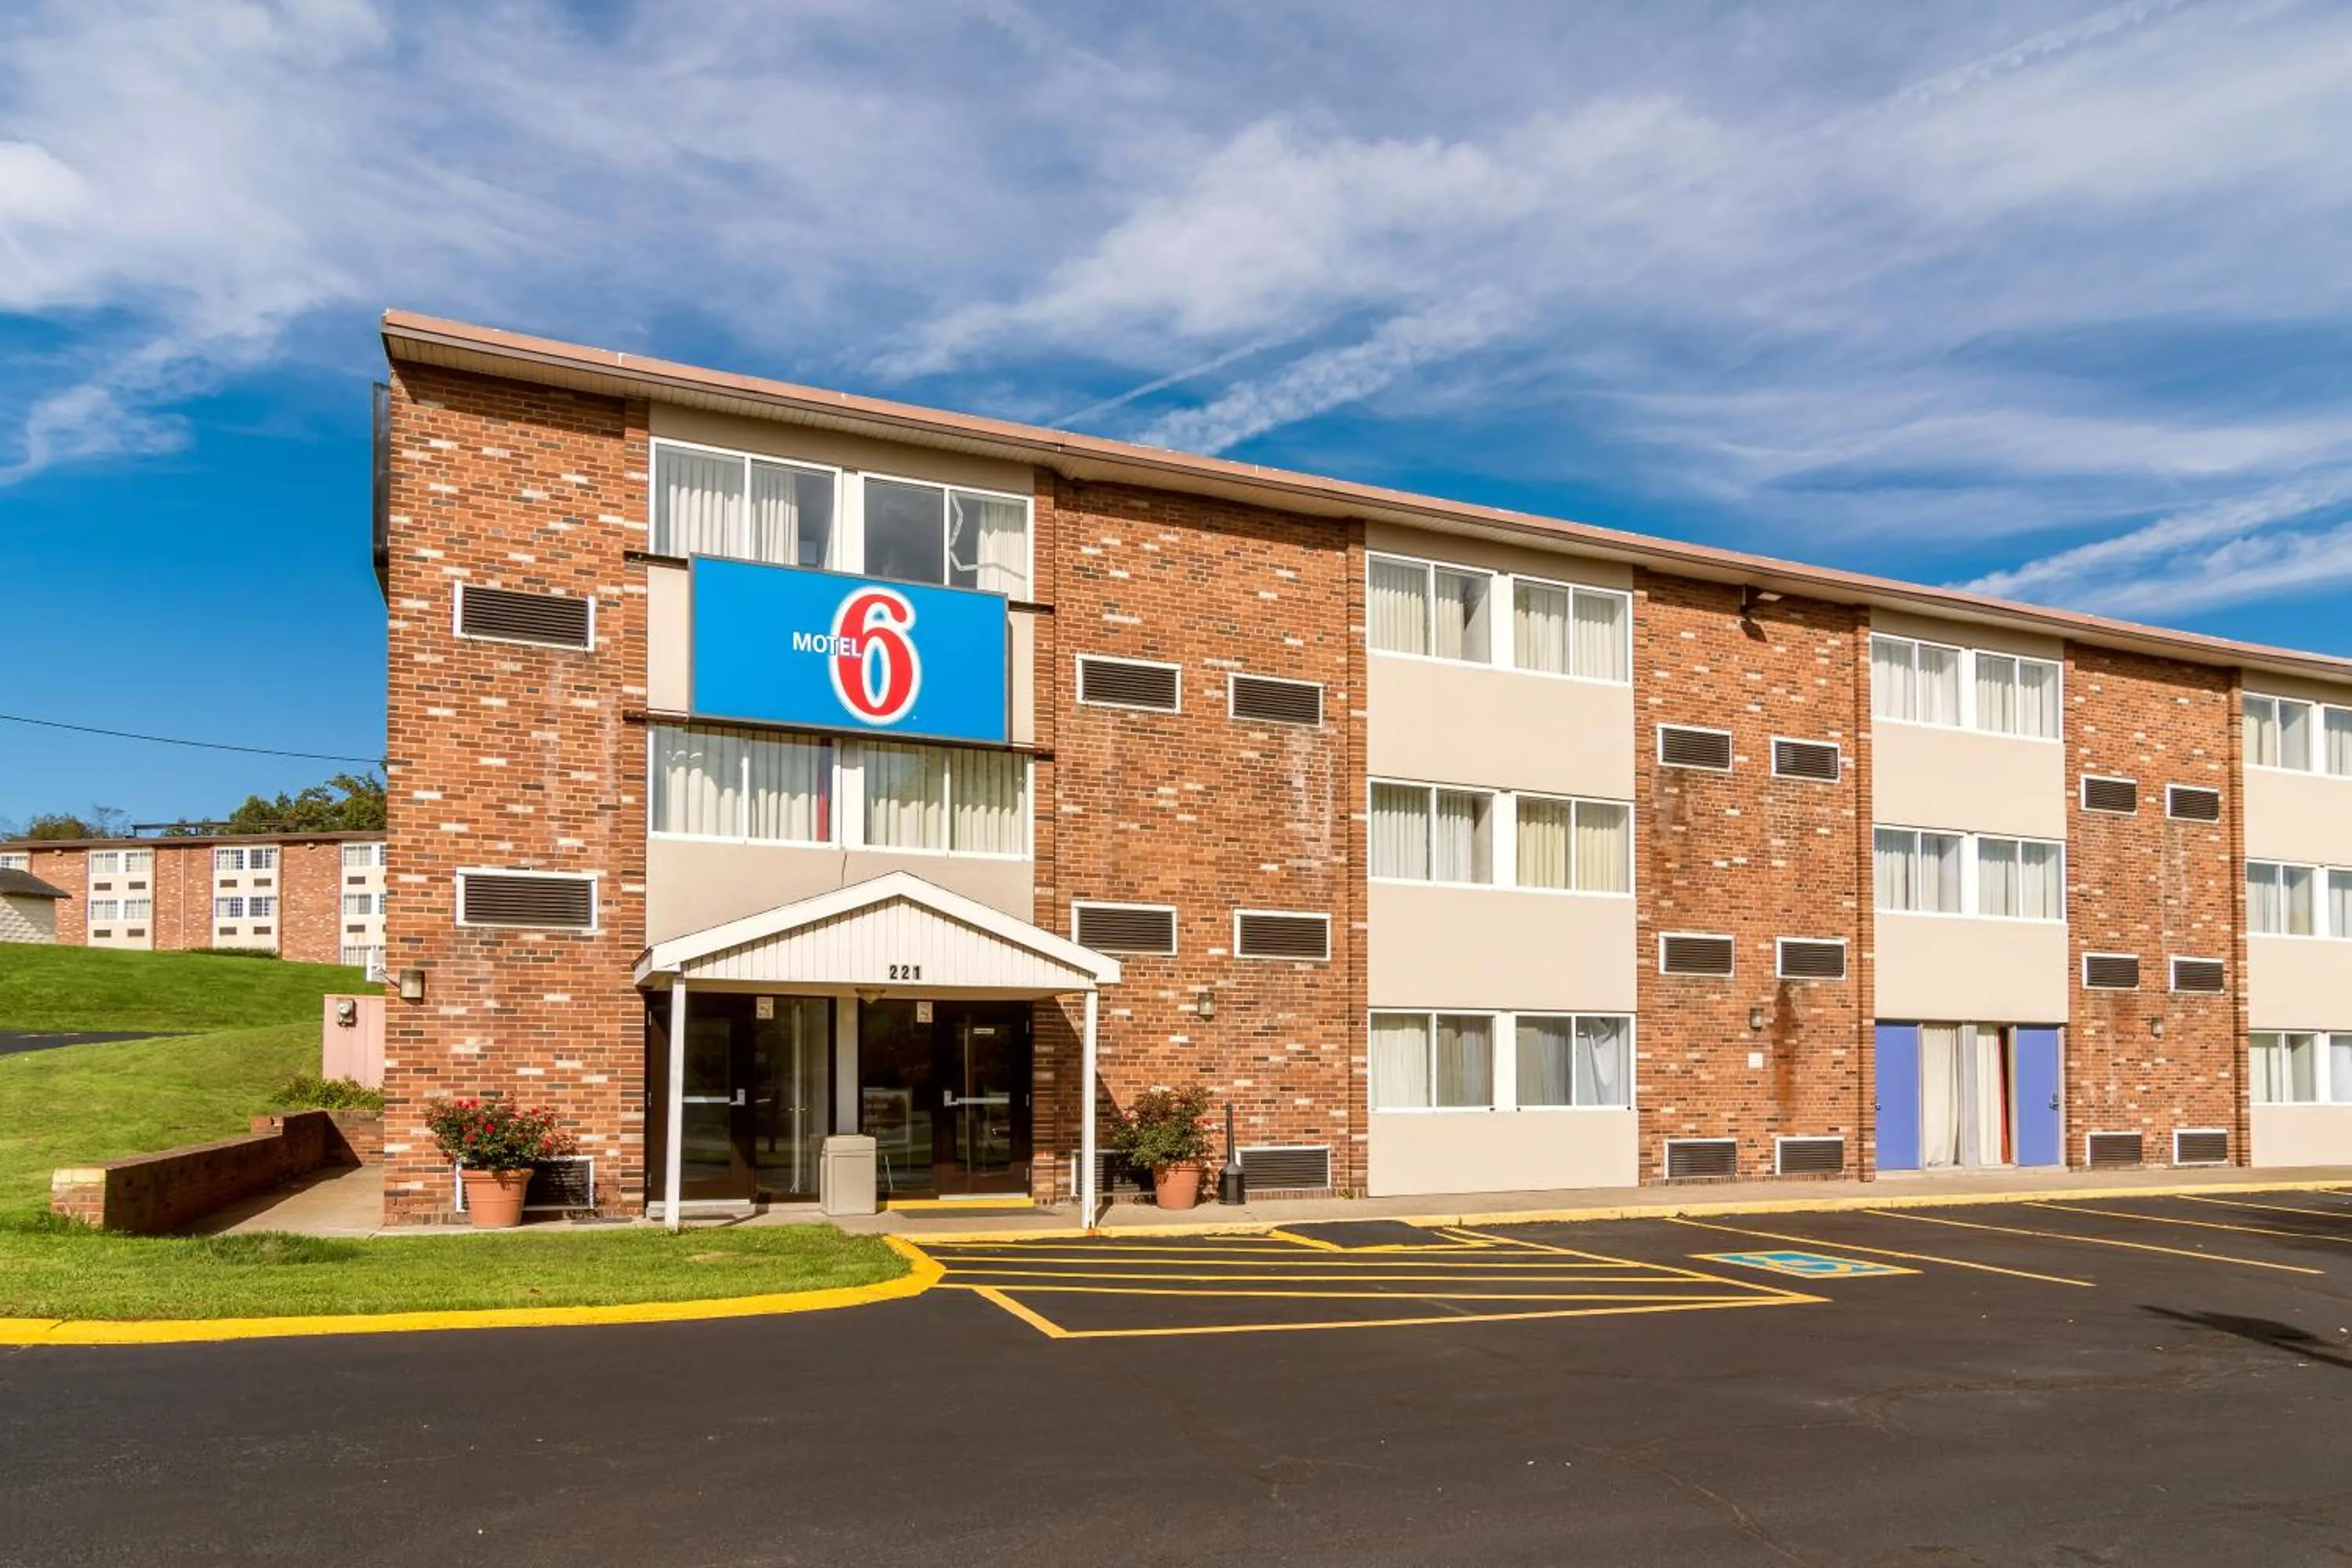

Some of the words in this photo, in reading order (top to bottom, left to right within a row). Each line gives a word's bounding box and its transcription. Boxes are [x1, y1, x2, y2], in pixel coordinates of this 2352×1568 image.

[793, 632, 862, 658] MOTEL
[829, 587, 922, 724] 6
[889, 965, 920, 980] 221
